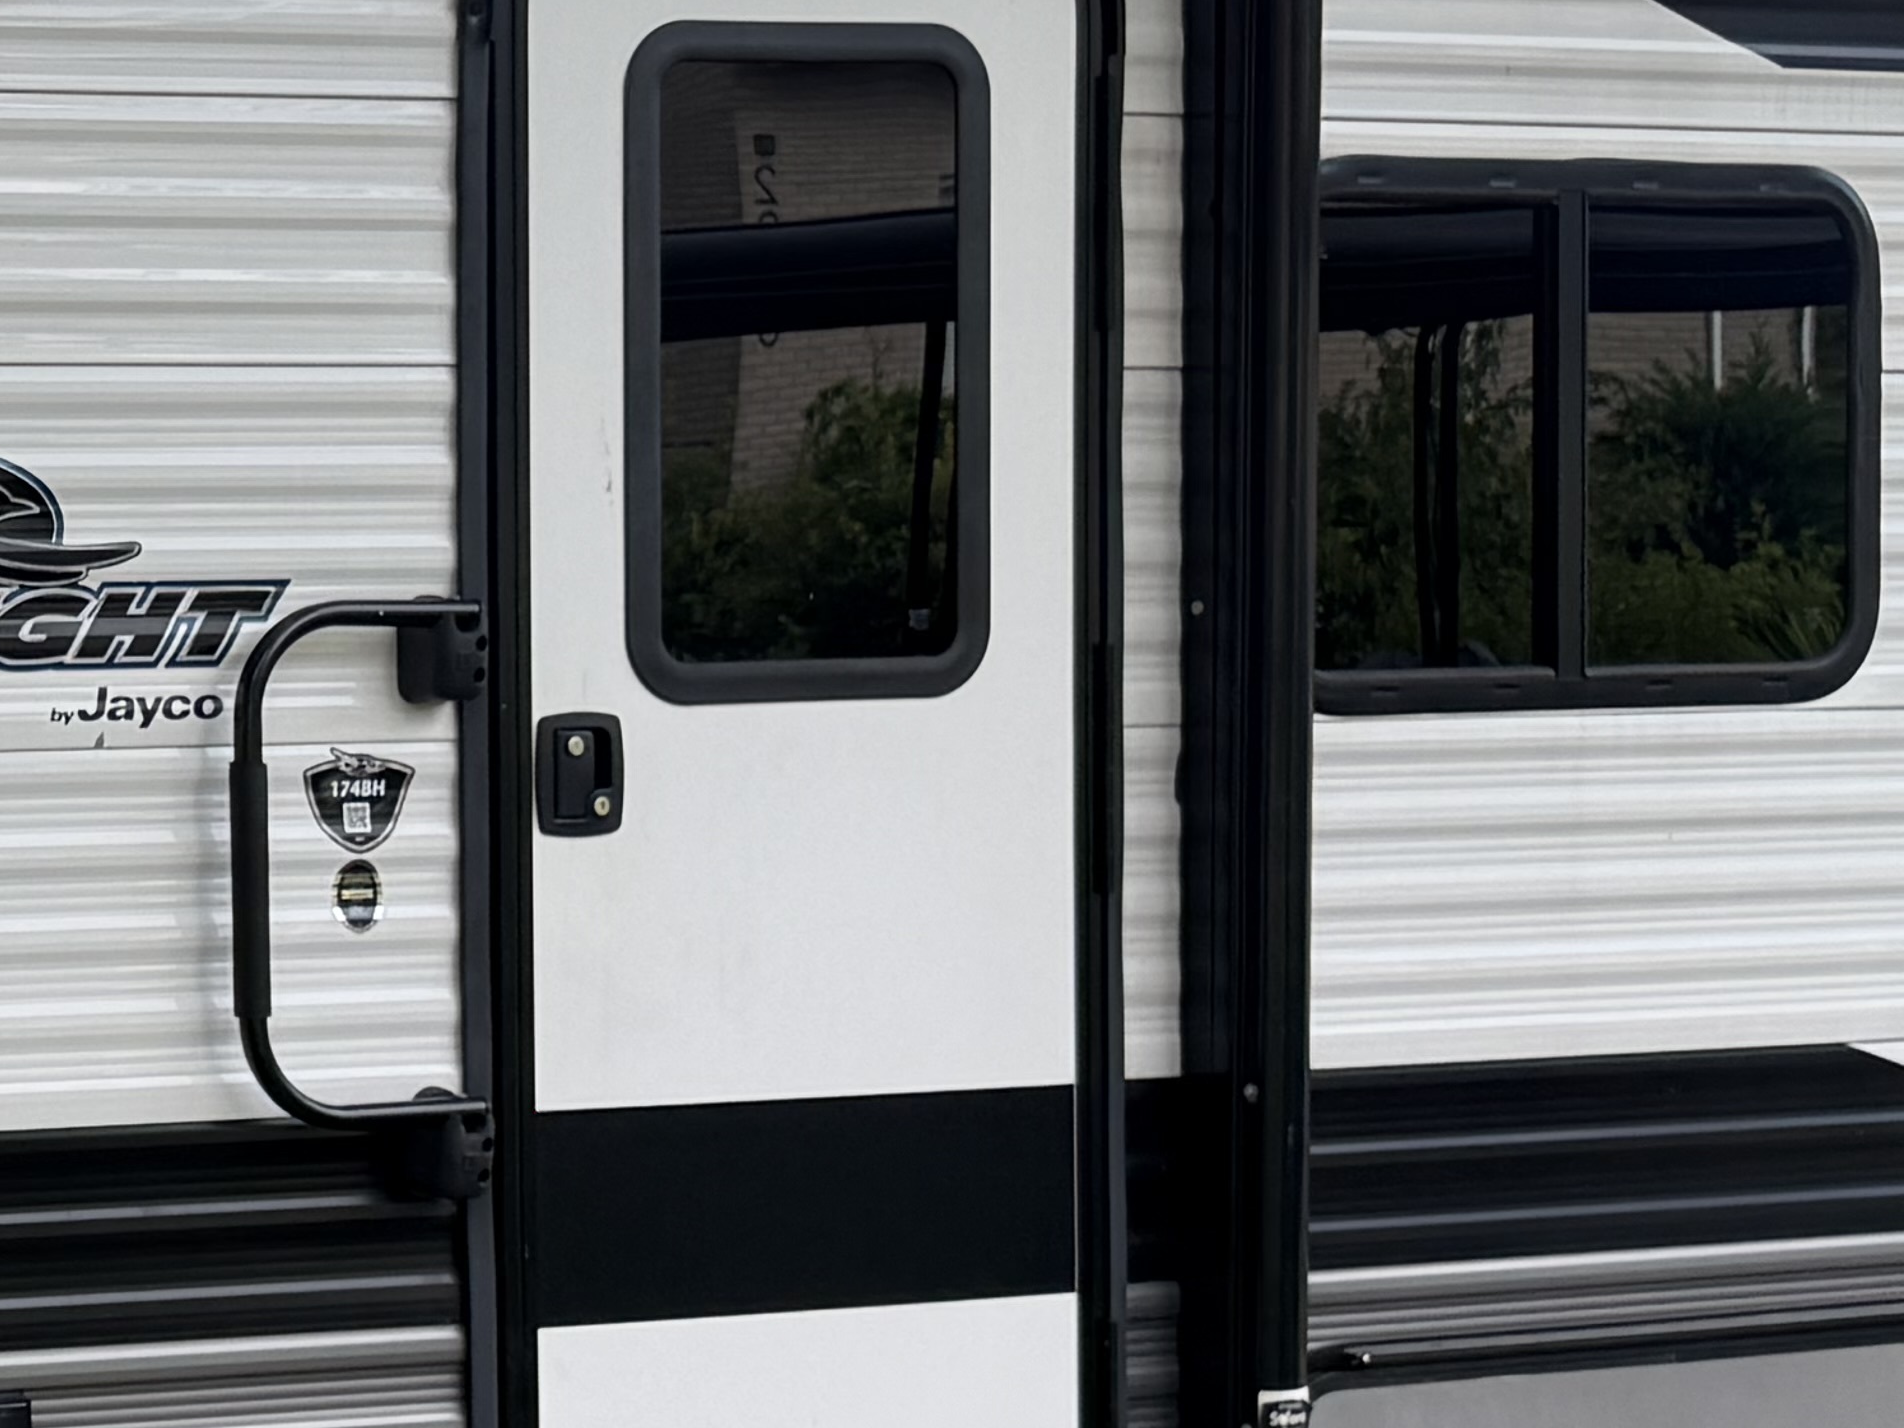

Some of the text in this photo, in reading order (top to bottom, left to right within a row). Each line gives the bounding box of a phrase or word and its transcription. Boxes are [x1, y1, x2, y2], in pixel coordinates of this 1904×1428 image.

[50, 685, 224, 729] by Jayco
[329, 779, 386, 798] 174BH
